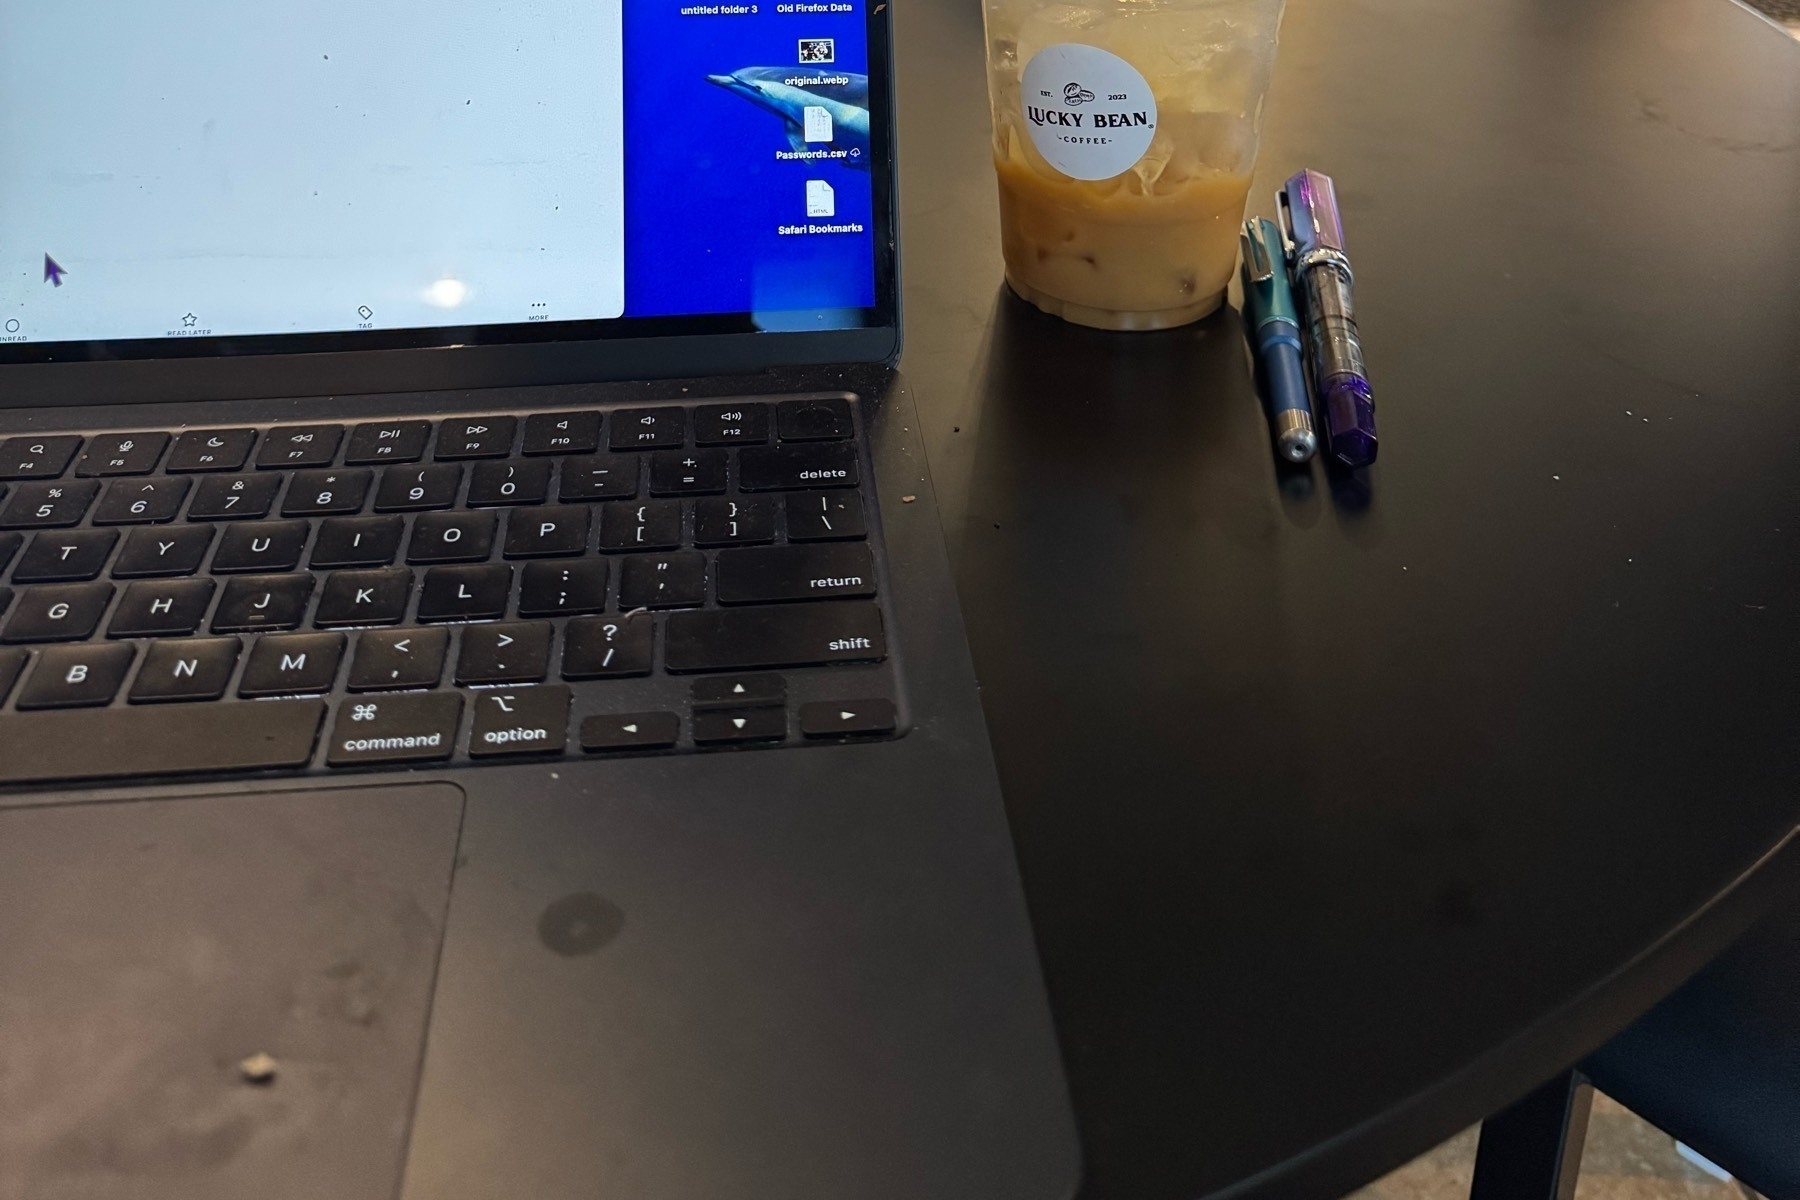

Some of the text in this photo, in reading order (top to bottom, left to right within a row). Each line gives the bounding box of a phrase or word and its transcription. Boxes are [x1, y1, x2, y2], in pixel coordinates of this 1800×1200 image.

[681, 5, 758, 15] untitled folder 3
[777, 3, 852, 13] Old Firefox Data
[784, 75, 849, 86] original.webp
[1027, 105, 1147, 129] LUCKY BEAN
[776, 149, 847, 159] Passwords.csv
[778, 223, 863, 235] Safari Bookmarks
[639, 433, 655, 441] F11
[110, 459, 124, 467] F5
[800, 470, 846, 479] delete
[540, 523, 556, 536] P
[159, 542, 174, 555] Y
[252, 538, 270, 552] U
[61, 546, 77, 560] T
[811, 577, 861, 587] return
[356, 588, 374, 603] K
[458, 584, 472, 598] L
[151, 598, 173, 614] H
[254, 593, 270, 608] J
[48, 603, 69, 619] G
[829, 638, 870, 650] shift
[174, 659, 197, 677] N
[281, 654, 306, 671] M
[66, 665, 88, 683] B
[344, 733, 440, 751] command
[484, 727, 546, 744] option
